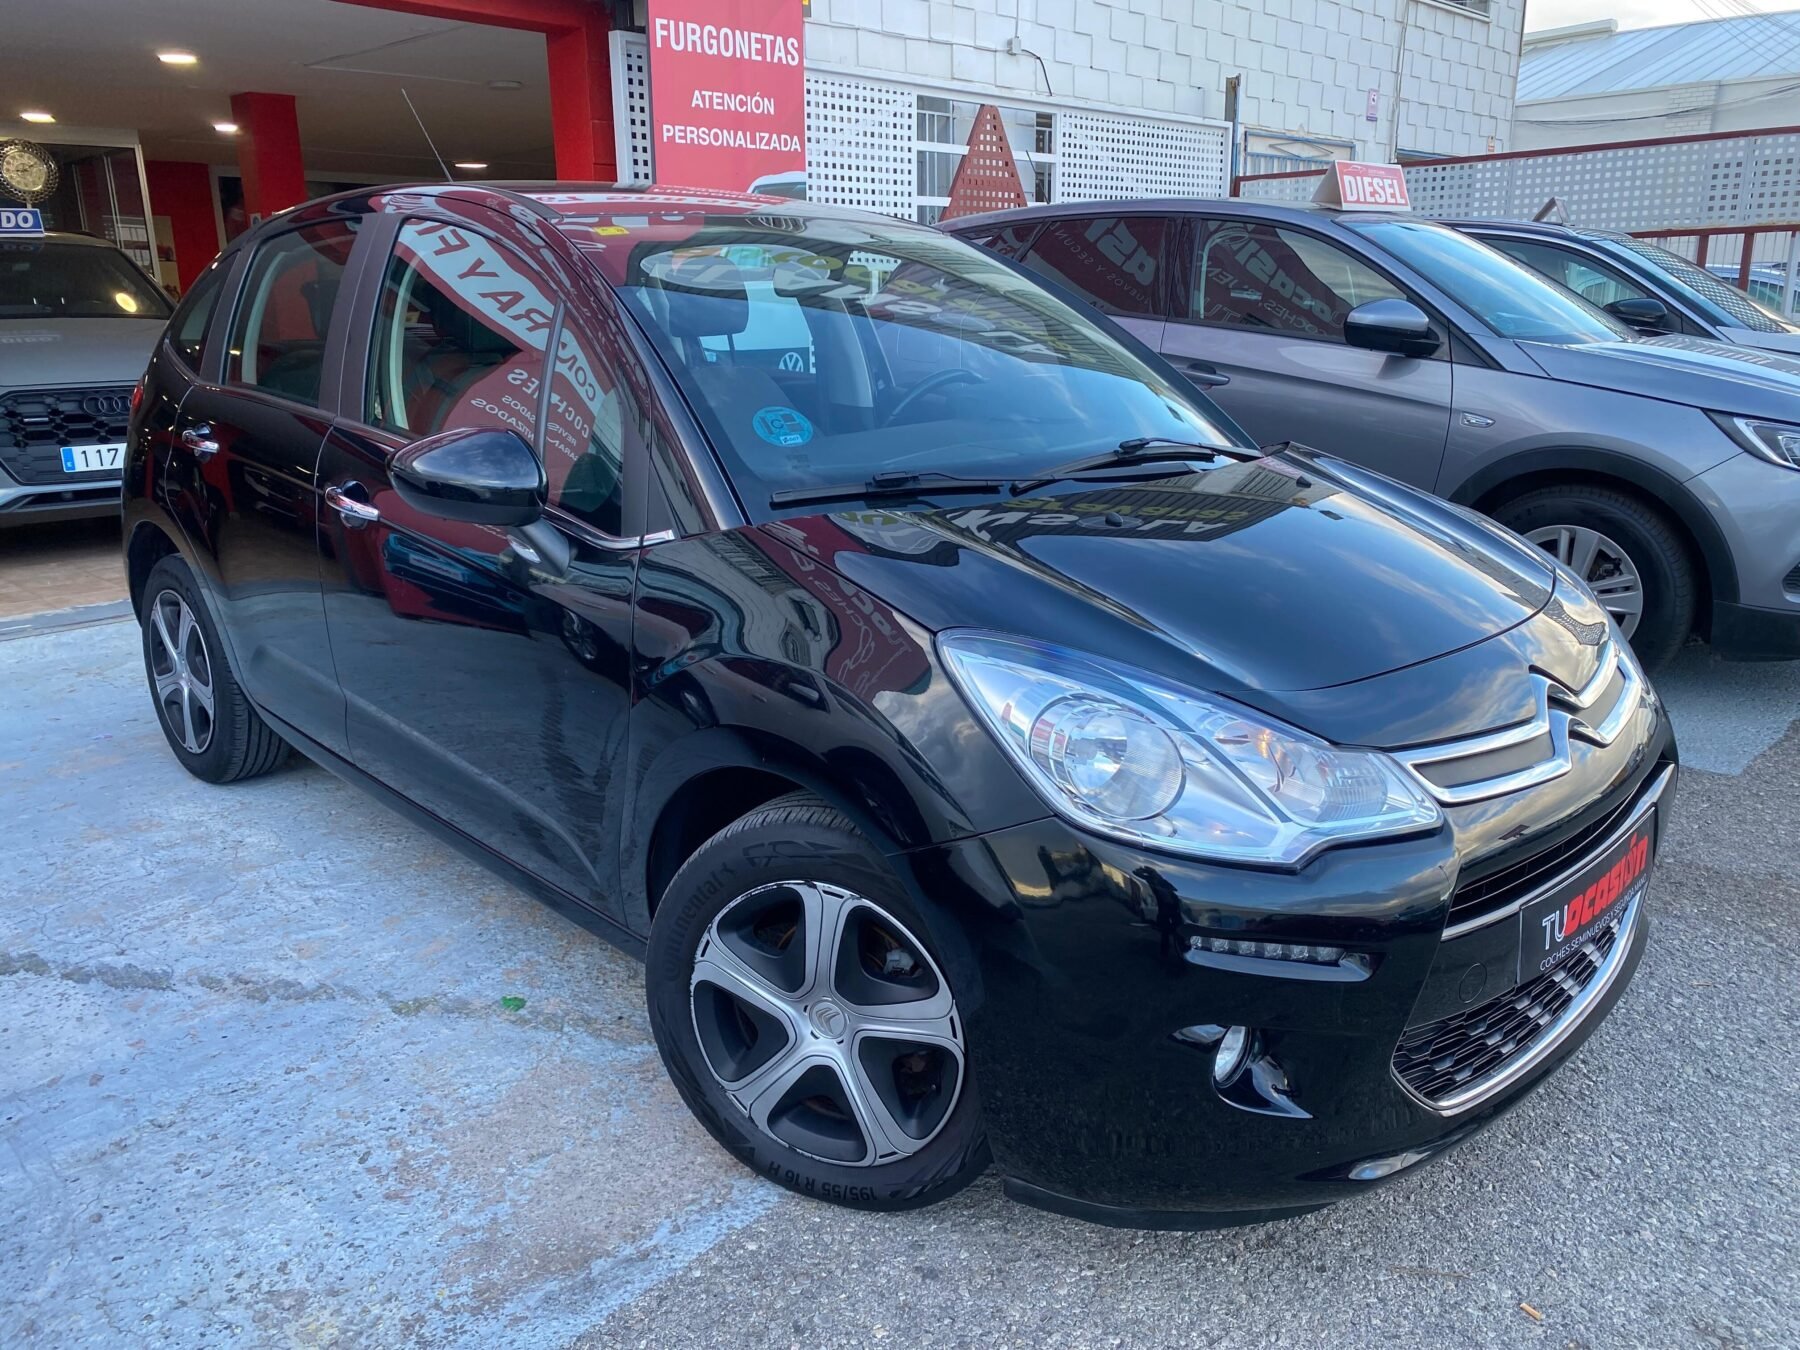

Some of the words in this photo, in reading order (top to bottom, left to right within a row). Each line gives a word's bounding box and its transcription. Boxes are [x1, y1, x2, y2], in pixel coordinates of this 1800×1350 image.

[655, 17, 799, 66] FURGONETAS
[691, 89, 775, 115] ATENCIÓN
[662, 124, 801, 152] PERSONALIZADA
[1343, 175, 1406, 204] DIESEL
[1540, 944, 1571, 972] COCHES
[1570, 912, 1611, 950] SEMINUEVOS
[820, 1182, 878, 1201] 195/55
